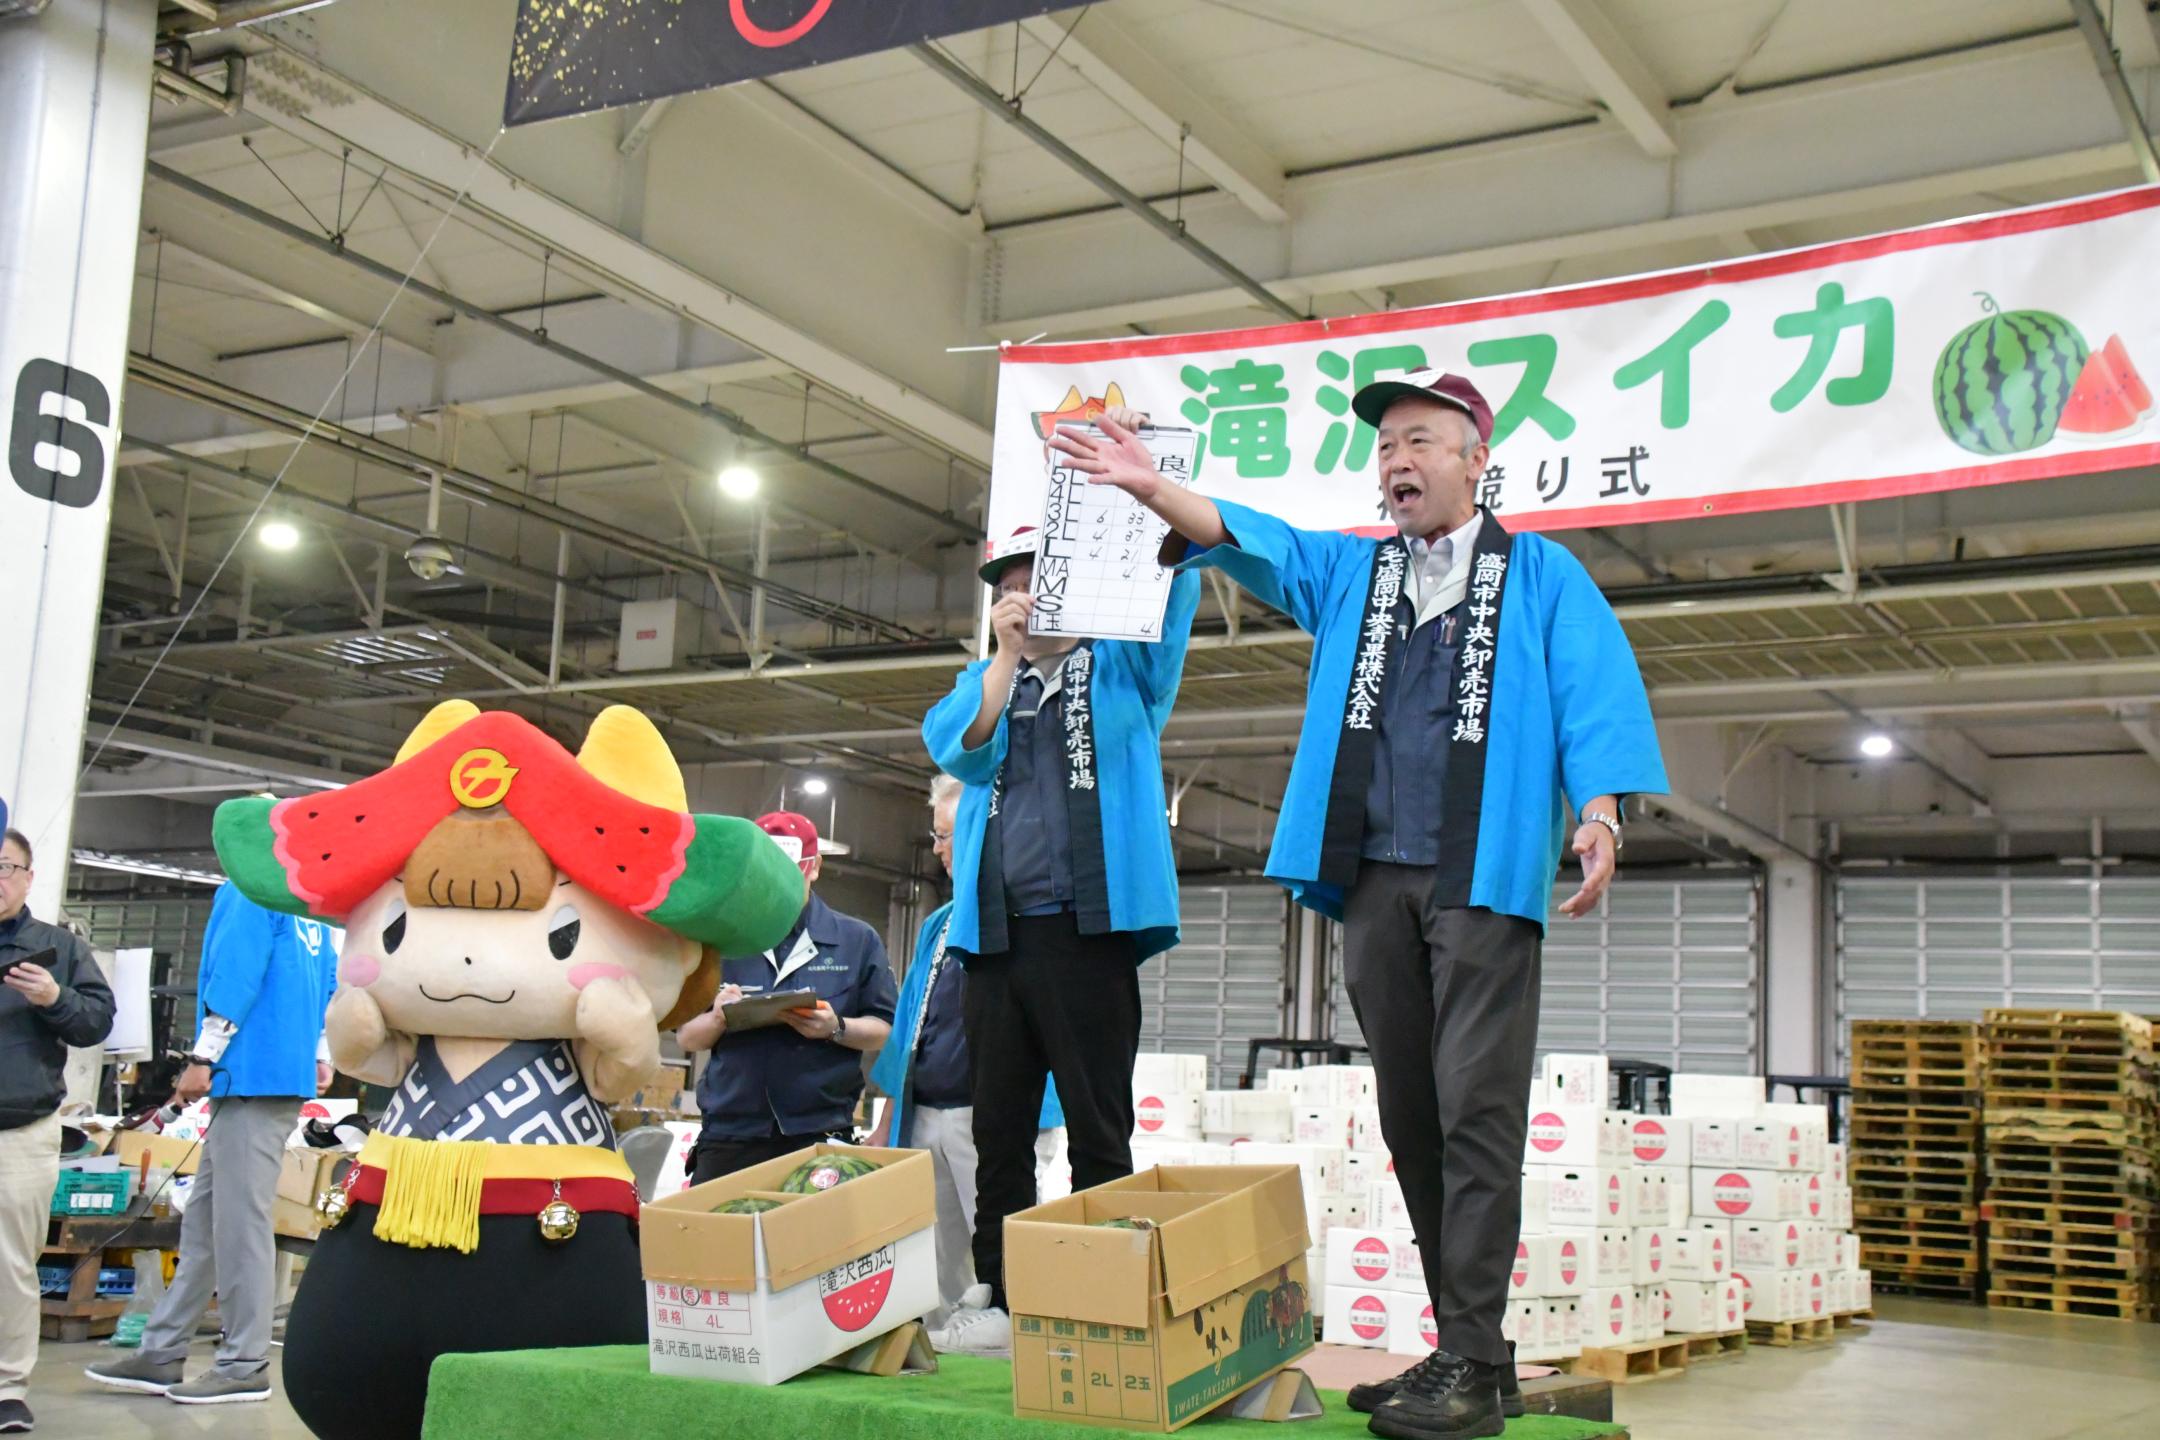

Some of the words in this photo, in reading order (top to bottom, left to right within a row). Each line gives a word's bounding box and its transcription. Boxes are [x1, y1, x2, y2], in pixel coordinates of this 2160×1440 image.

[8, 357, 111, 508] 6
[1157, 455, 1188, 474] 良
[1051, 466, 1085, 486] 5L
[1049, 484, 1082, 504] 4L
[1047, 502, 1079, 523] 3L
[1044, 520, 1076, 542] 2L
[1092, 527, 1109, 542] 4
[1043, 538, 1072, 559] L
[1089, 546, 1103, 561] 4
[1039, 557, 1070, 577] MA
[1036, 575, 1068, 595] M
[1034, 593, 1063, 613] S
[1032, 612, 1062, 632] 1玉
[1140, 621, 1155, 636] 4
[1452, 552, 1507, 744] 盛岡市中央卸売市場
[822, 1245, 892, 1294] 滝沢西瓜
[657, 1308, 682, 1326] 規格
[706, 1314, 725, 1329] 4L
[652, 1338, 761, 1366] 滝沢西瓜出荷組合
[1090, 1372, 1114, 1388] 2L
[1124, 1375, 1152, 1391] 2玉
